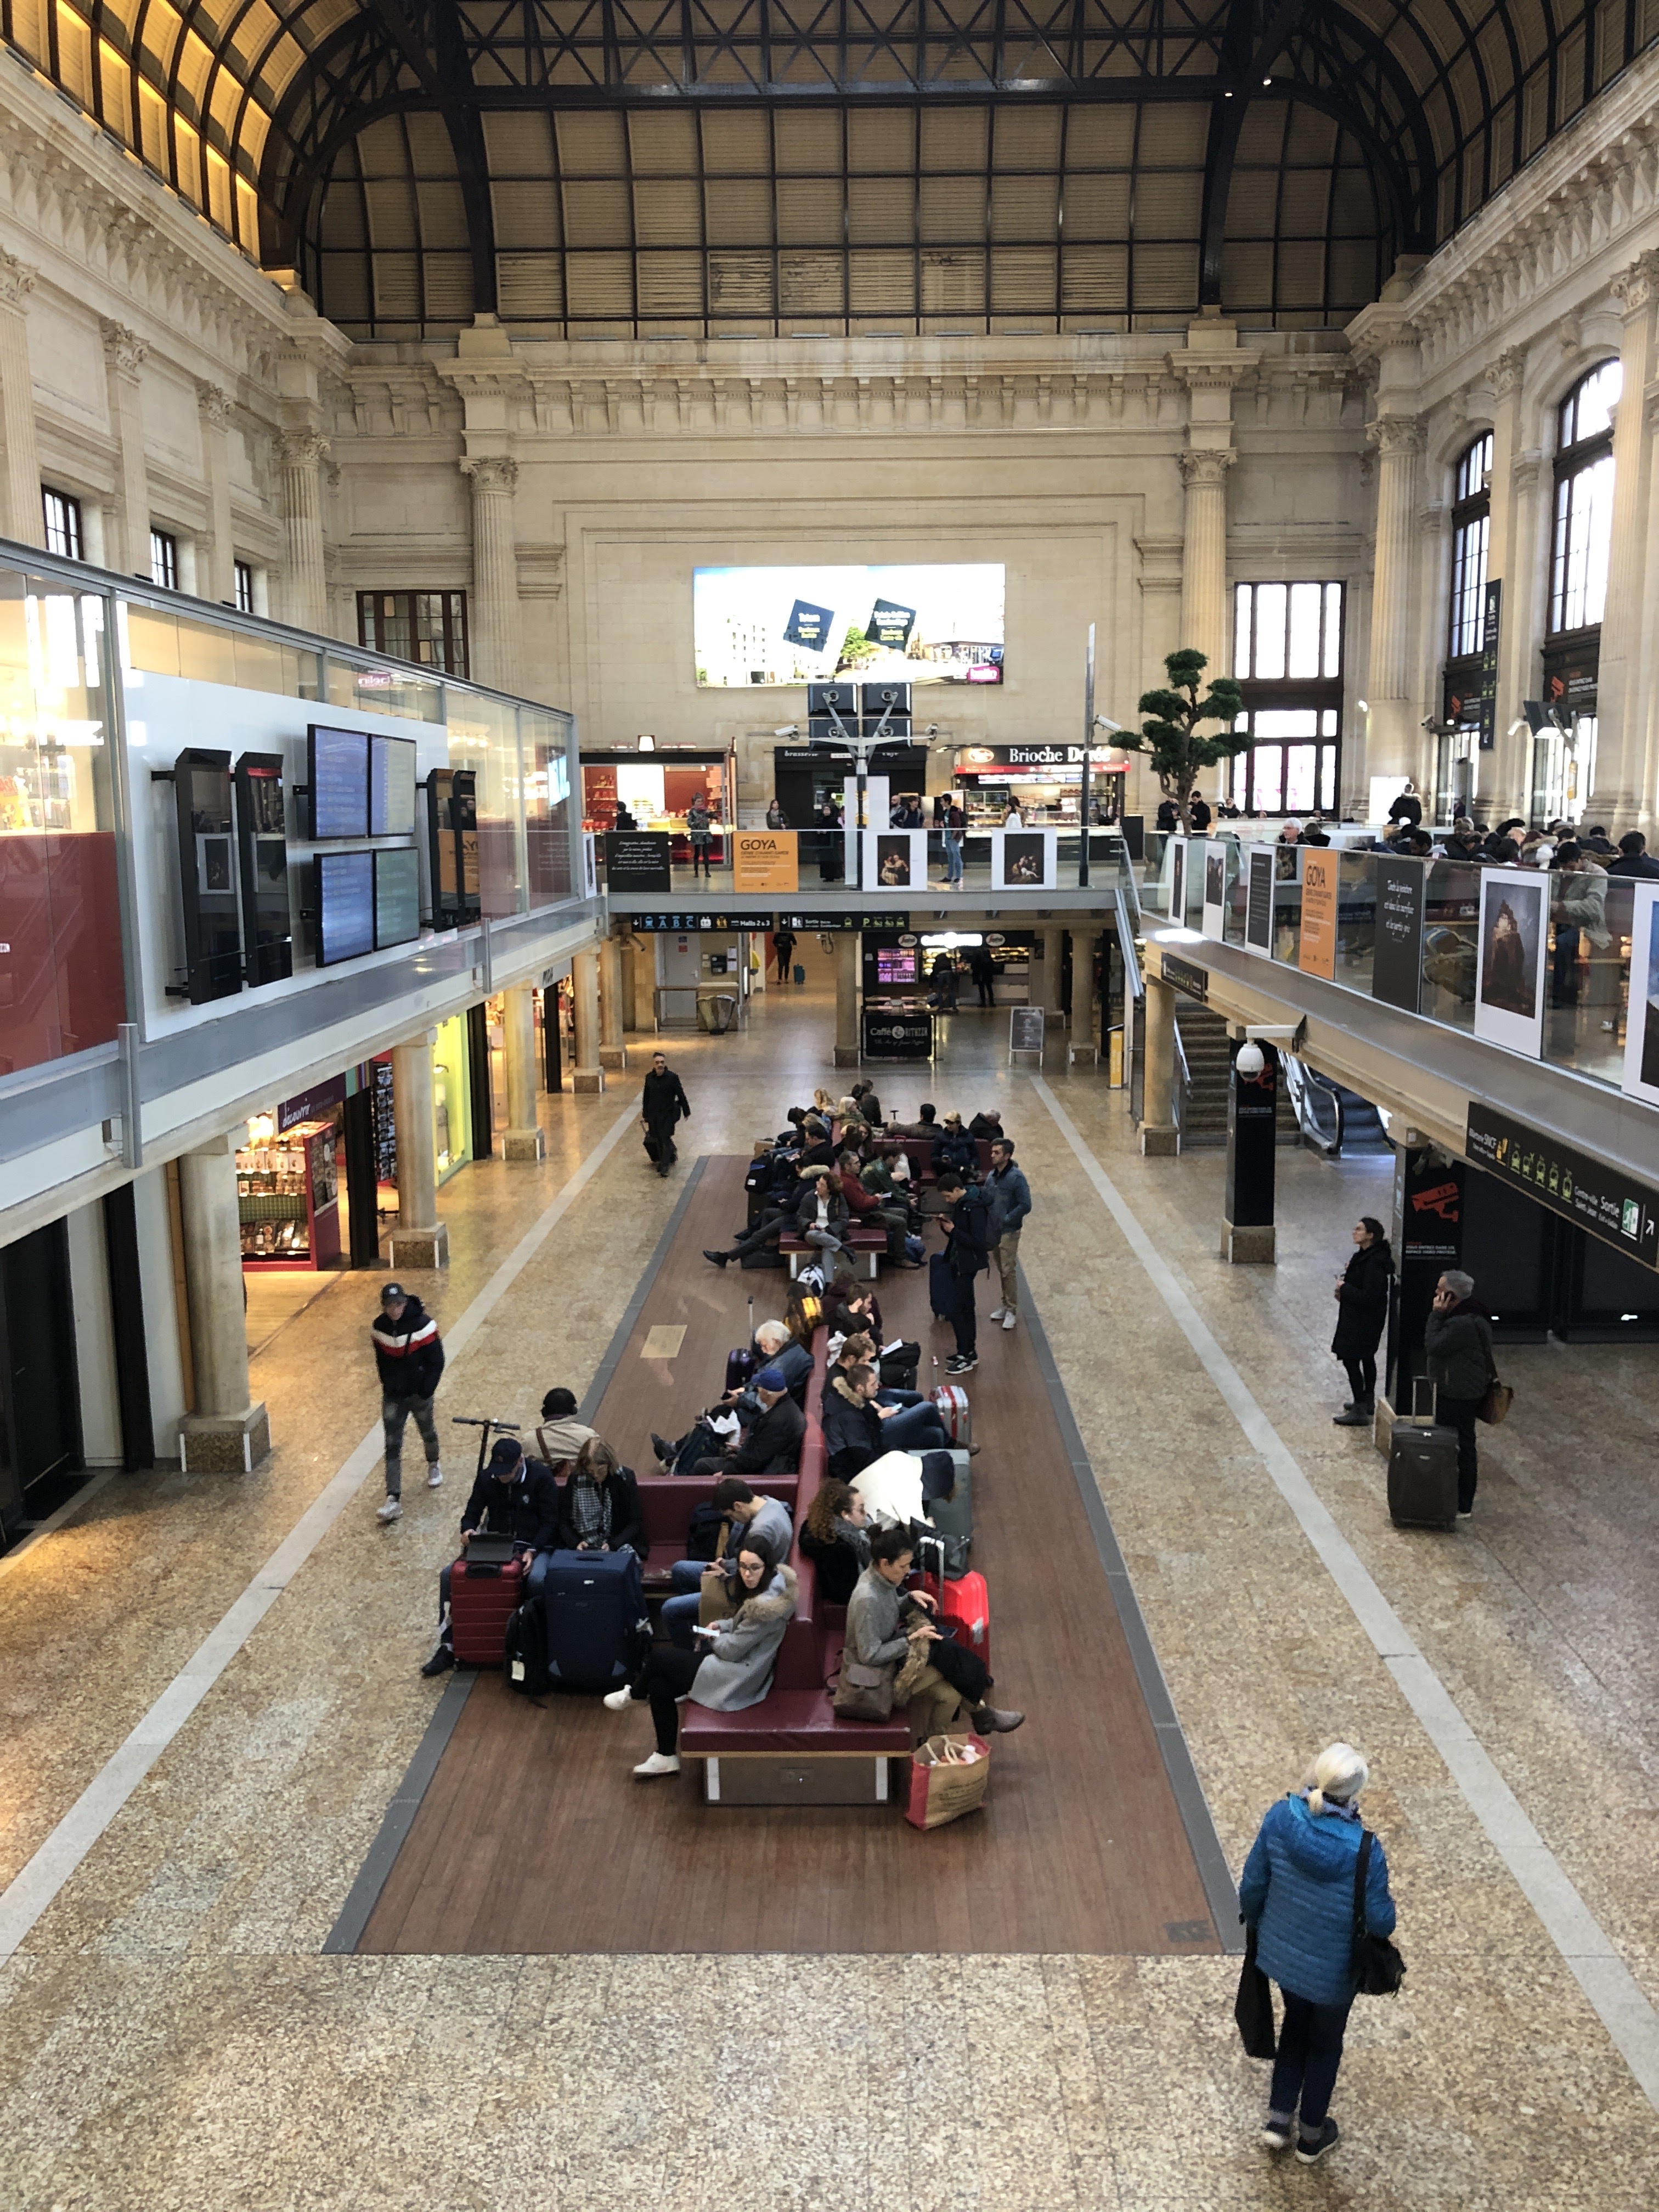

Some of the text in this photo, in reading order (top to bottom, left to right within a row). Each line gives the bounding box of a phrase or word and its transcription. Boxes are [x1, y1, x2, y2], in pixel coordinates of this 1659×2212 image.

[1009, 746, 1063, 763] Brioche
[741, 839, 777, 850] GOYA
[1306, 865, 1325, 888] GOYA
